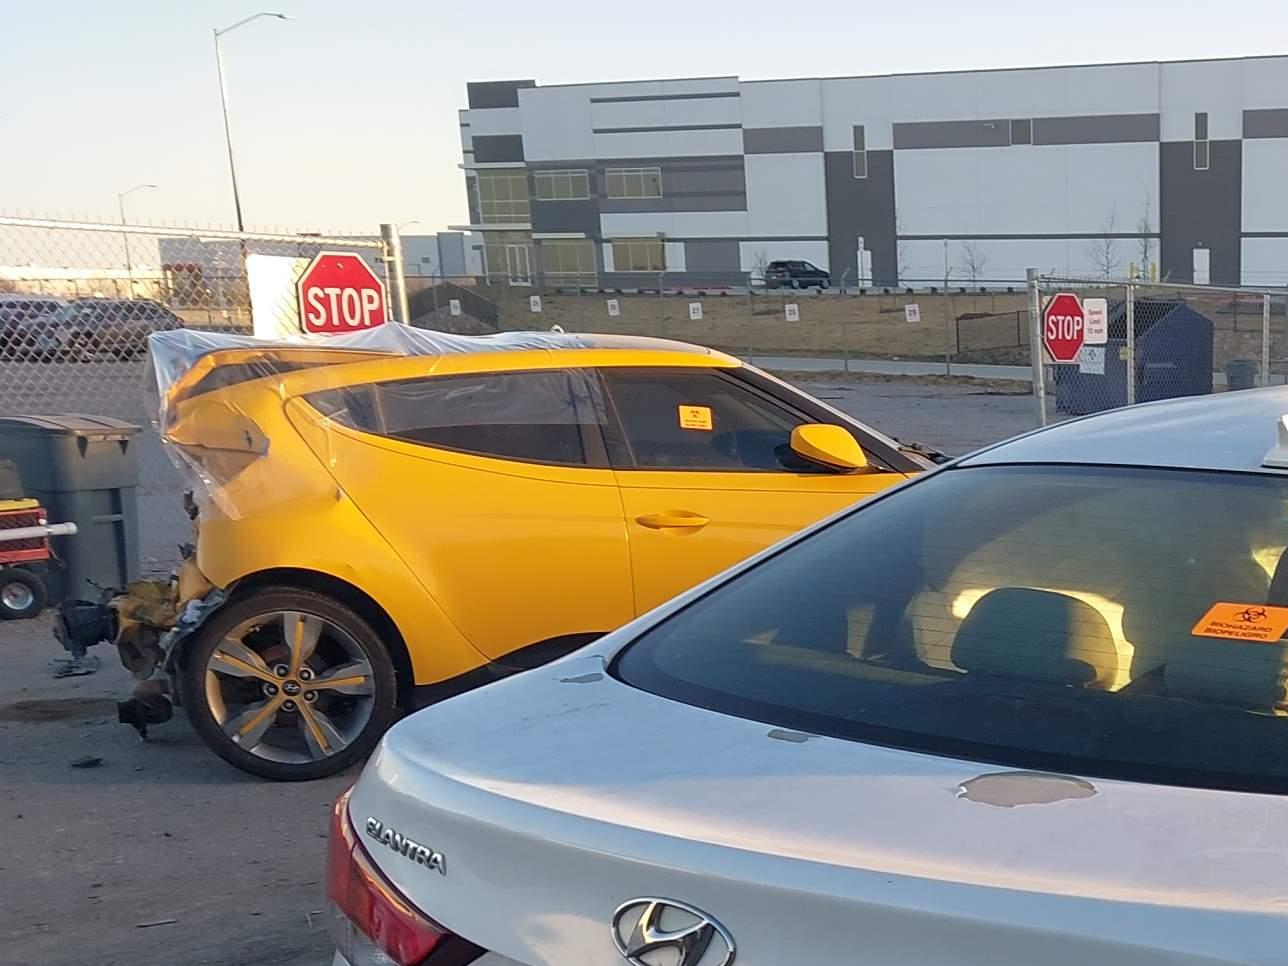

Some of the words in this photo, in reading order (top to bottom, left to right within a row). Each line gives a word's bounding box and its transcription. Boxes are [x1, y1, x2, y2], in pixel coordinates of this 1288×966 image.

[307, 286, 380, 327] STOP
[1047, 315, 1083, 340] STOP
[1204, 627, 1268, 639] BIOPELIGRO
[1210, 621, 1273, 633] BIOHAZARD
[366, 816, 446, 876] ELANTRA
